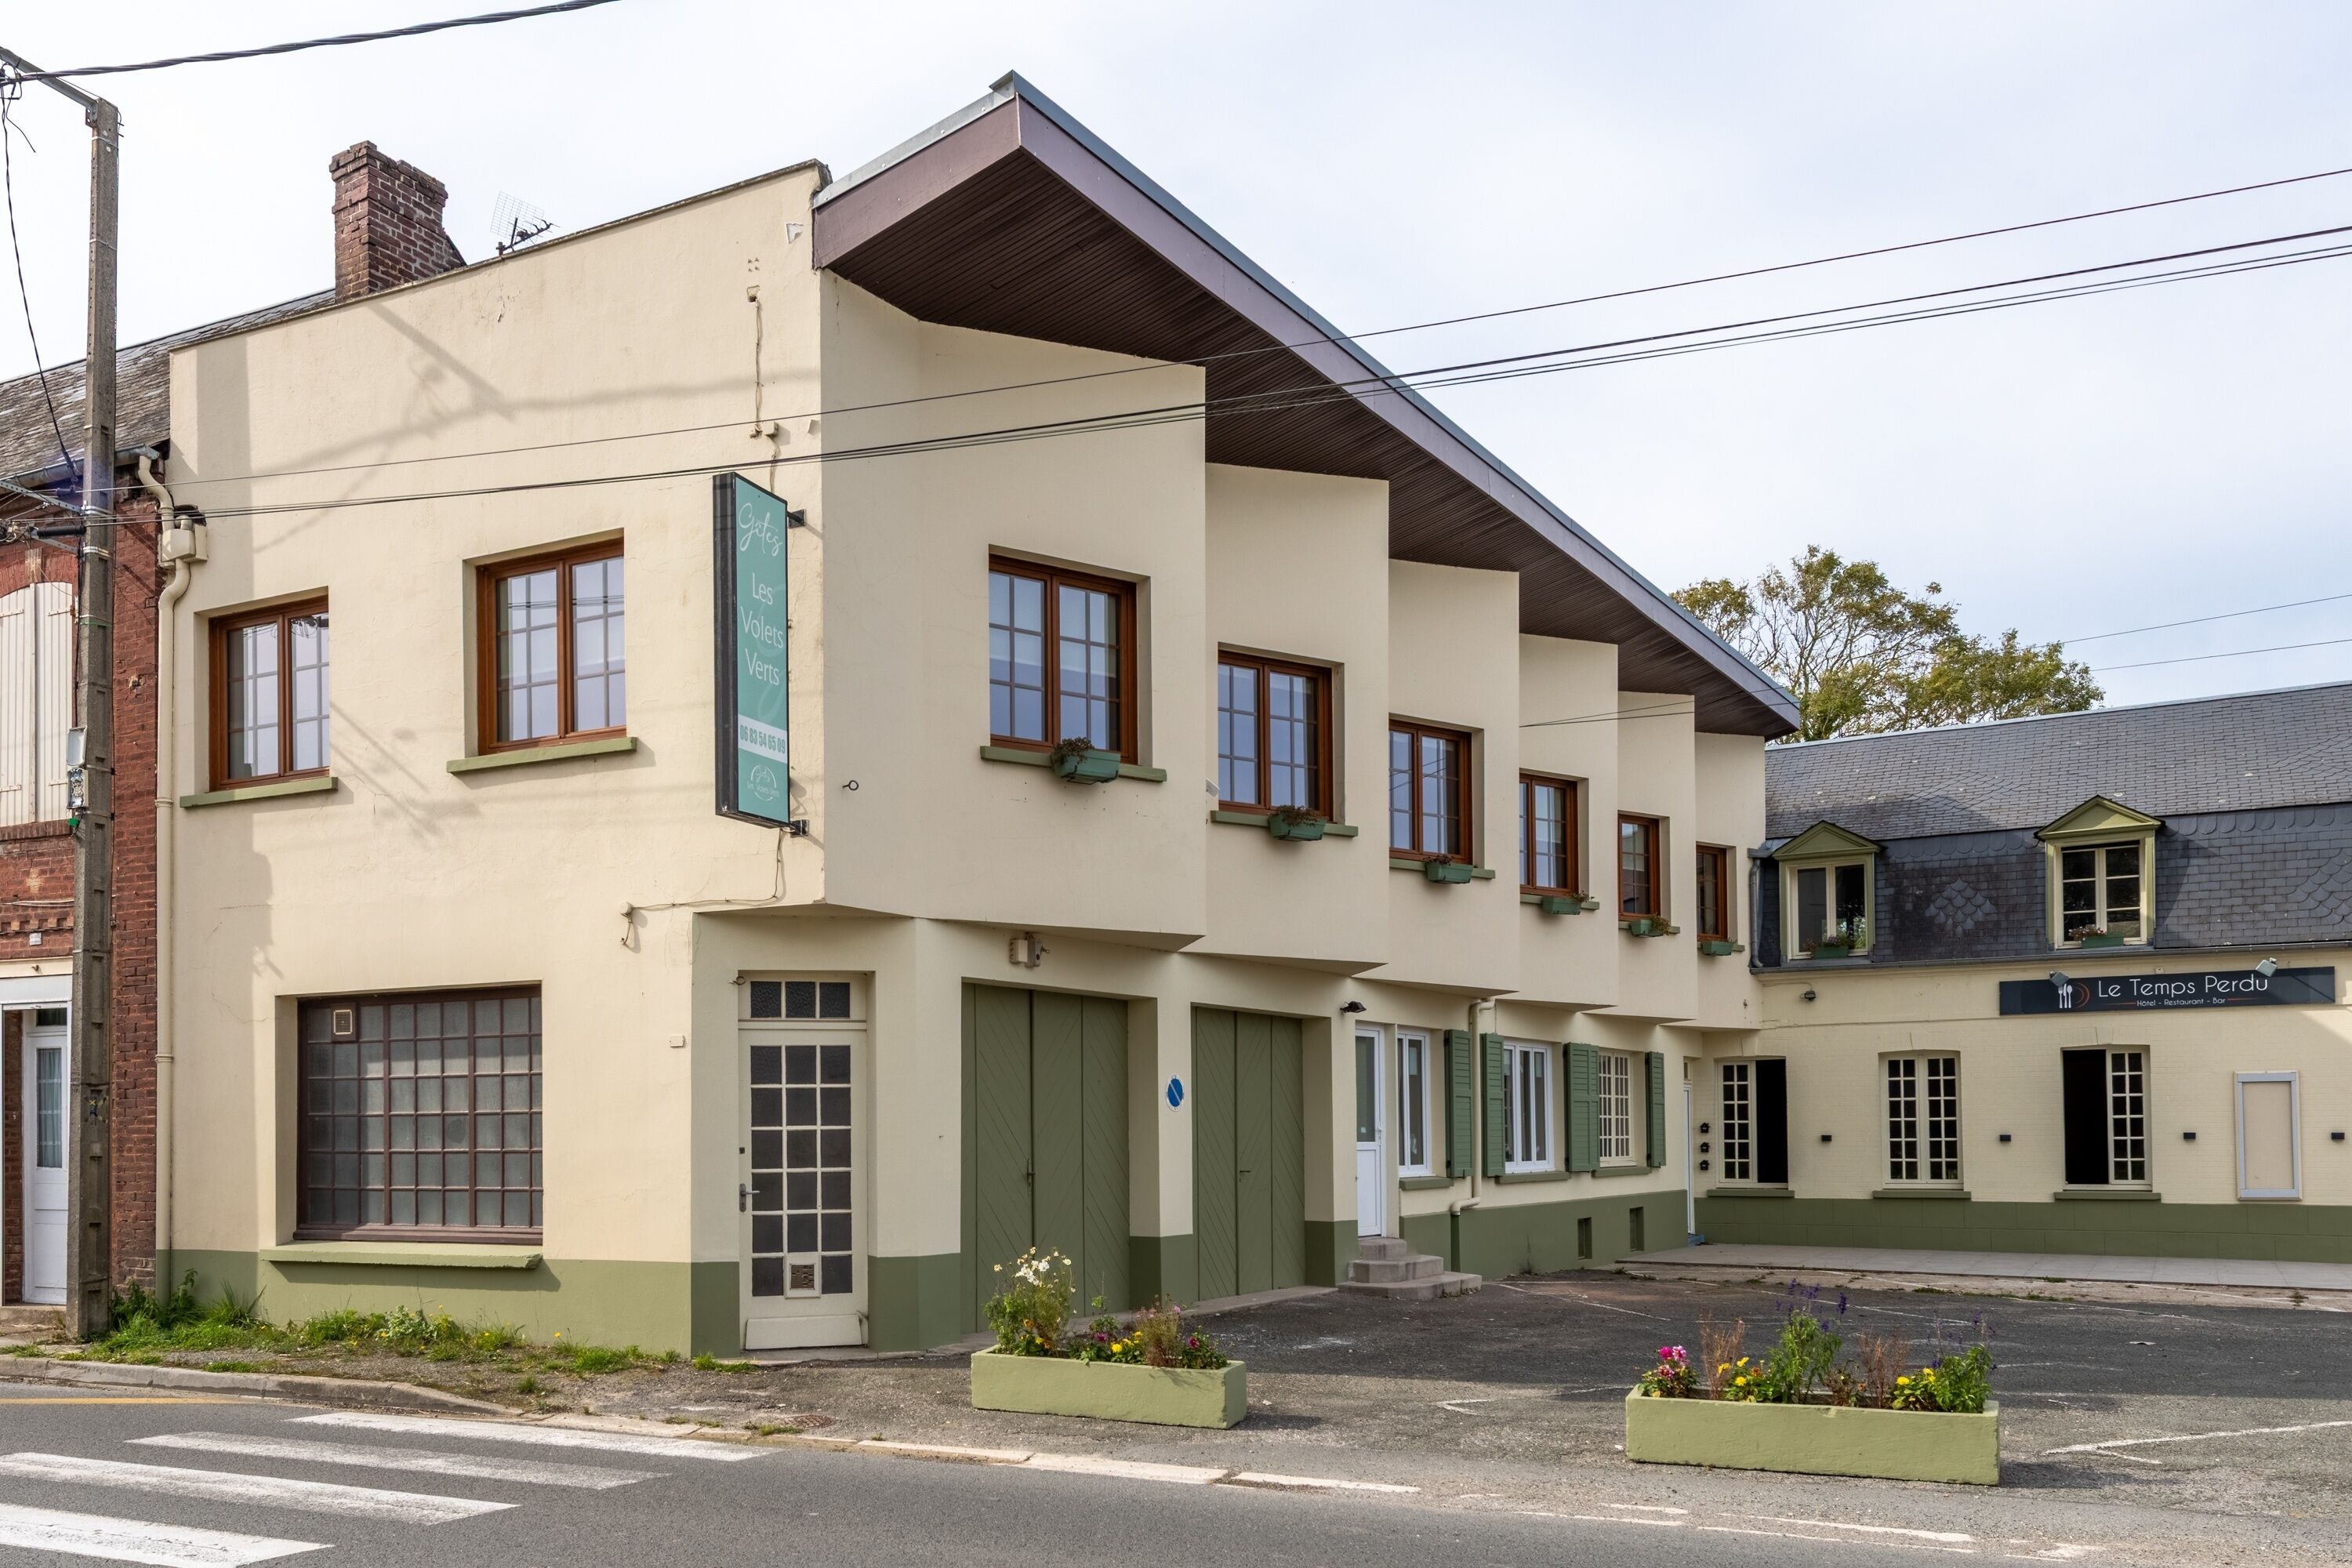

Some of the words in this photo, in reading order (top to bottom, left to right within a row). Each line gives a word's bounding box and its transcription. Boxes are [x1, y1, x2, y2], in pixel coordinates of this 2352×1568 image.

[739, 503, 783, 557] Gîtes
[752, 572, 773, 605] Les
[740, 606, 784, 648] Volets
[745, 648, 779, 686] Verts
[740, 724, 748, 742] 06
[750, 728, 758, 745] 83
[758, 731, 767, 748] 54
[768, 734, 776, 751] 65
[777, 737, 786, 754] 09
[2098, 980, 2122, 997] Le
[2129, 978, 2195, 998] Temps
[2205, 974, 2268, 993] Perdu
